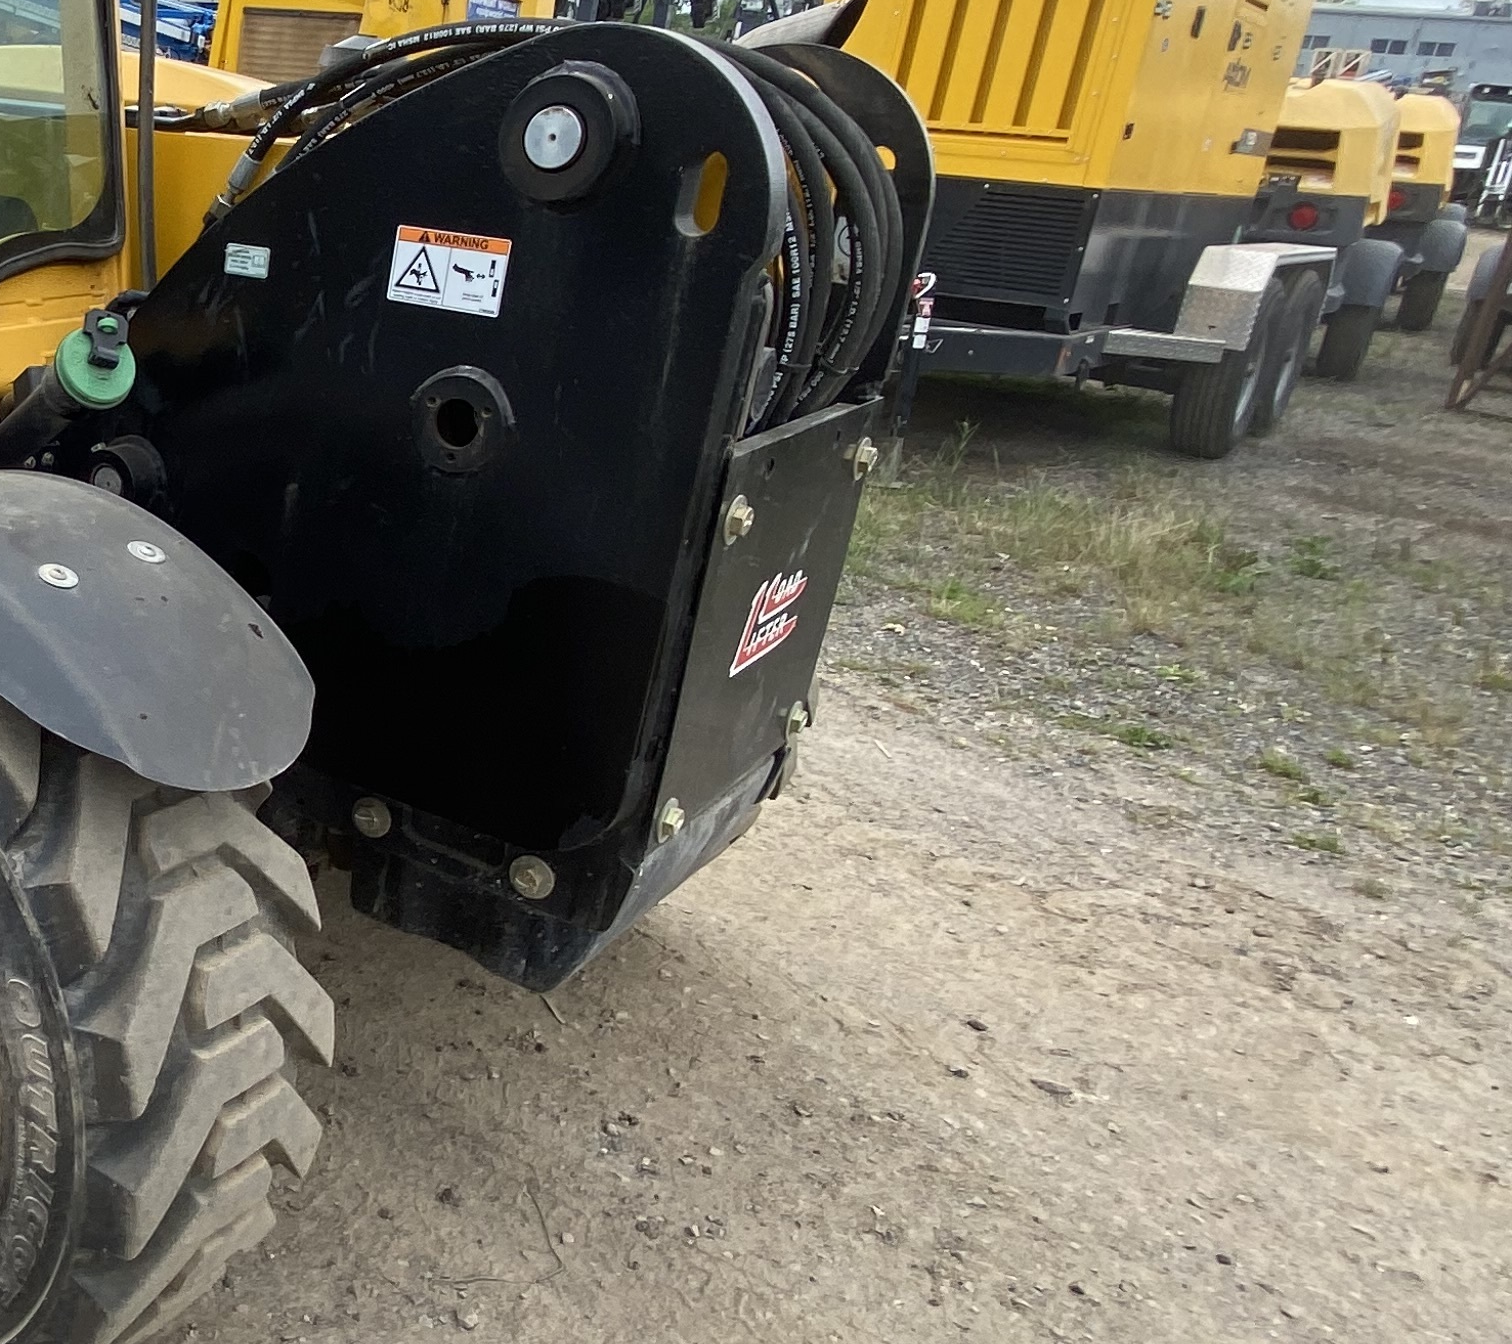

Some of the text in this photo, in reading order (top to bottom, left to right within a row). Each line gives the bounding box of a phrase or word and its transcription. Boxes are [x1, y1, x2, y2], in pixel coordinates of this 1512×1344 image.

[455, 26, 472, 36] SAE
[434, 232, 489, 250] WARNING
[792, 278, 801, 299] SAE
